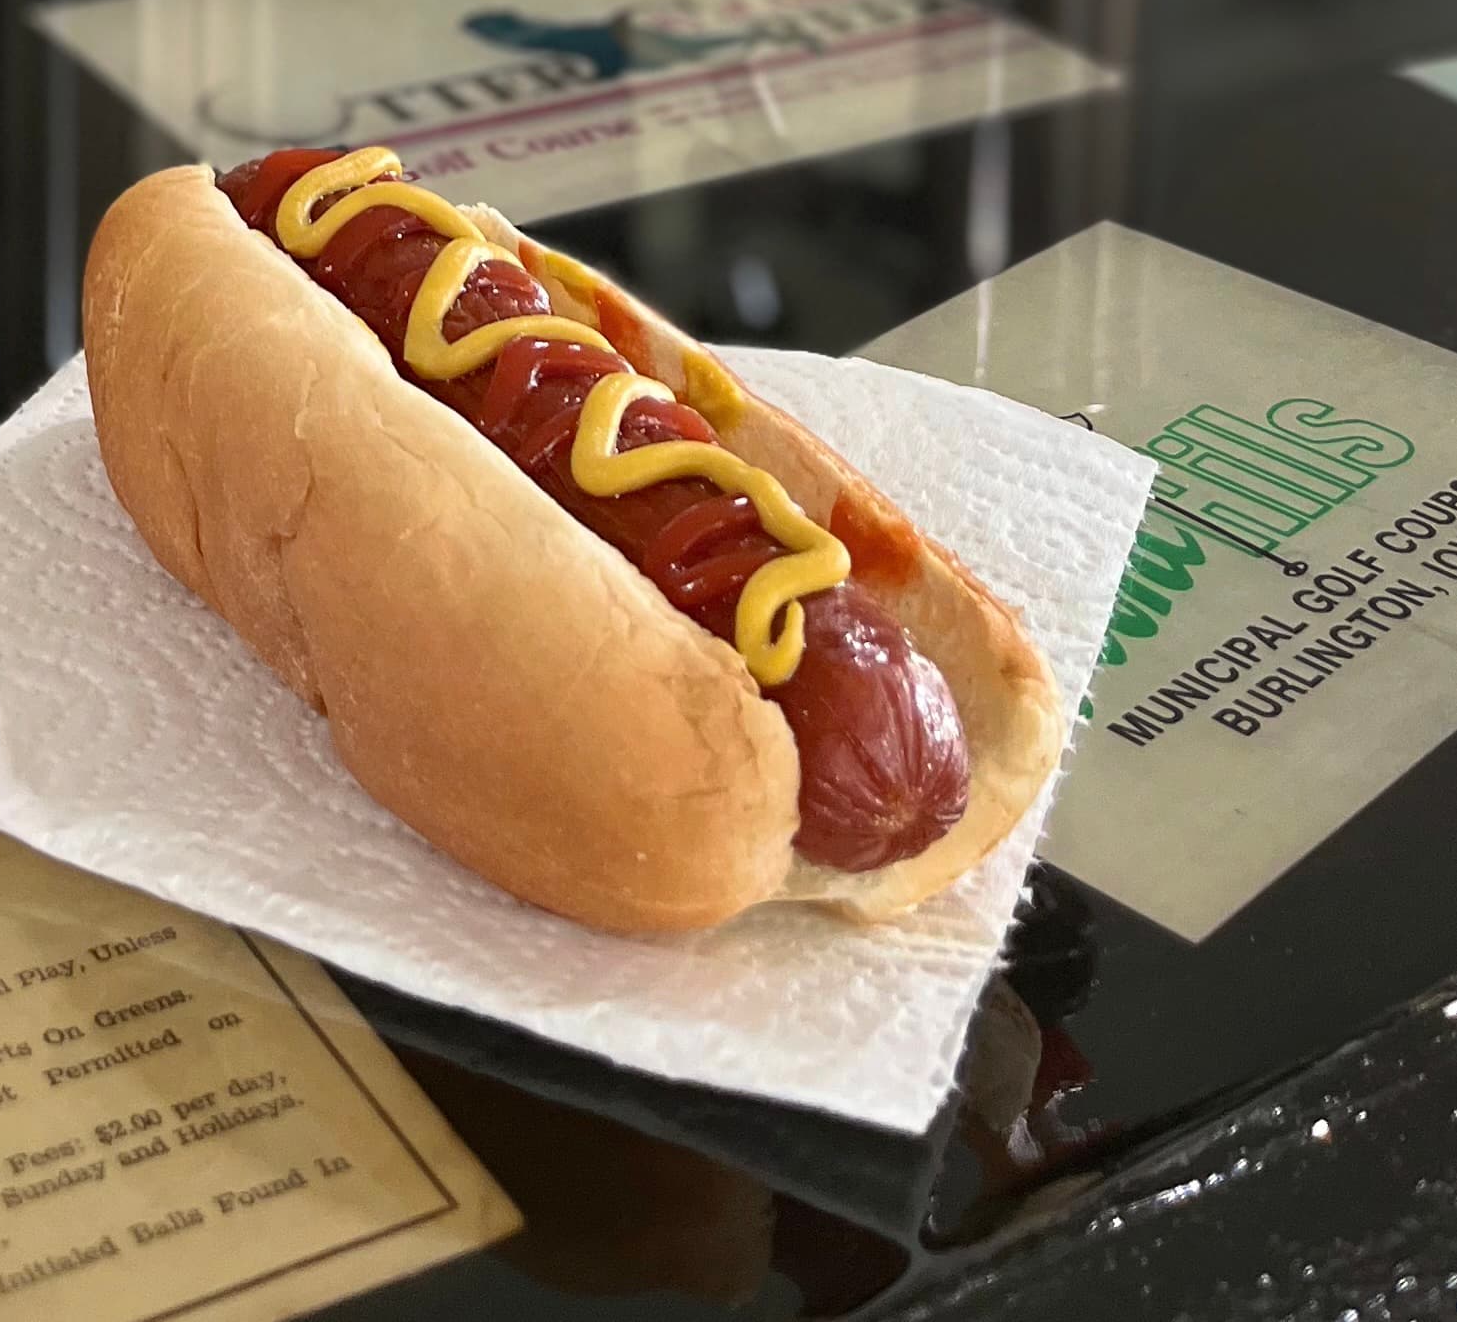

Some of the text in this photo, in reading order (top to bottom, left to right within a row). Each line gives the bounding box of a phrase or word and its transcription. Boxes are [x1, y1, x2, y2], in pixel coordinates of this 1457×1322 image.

[1107, 479, 1457, 747] MUNICIPAL GOLF COUR
[1212, 578, 1449, 737] BURLINGTON,
[16, 958, 85, 988] Play,
[88, 924, 177, 963] Unless
[44, 1024, 84, 1045] On
[94, 988, 193, 1029] Greens.
[46, 1028, 182, 1086] Permitted
[208, 1010, 243, 1030] on
[2, 1158, 107, 1209] Sunday
[120, 1138, 171, 1168] and
[177, 1094, 305, 1148] Holidays.
[6, 1138, 85, 1175] Fees:
[95, 1109, 163, 1145] $2.00
[171, 1092, 216, 1122] per
[227, 1068, 287, 1097] day,
[130, 1208, 205, 1245] Balls
[216, 1169, 309, 1216] Found
[321, 1154, 352, 1178] In
